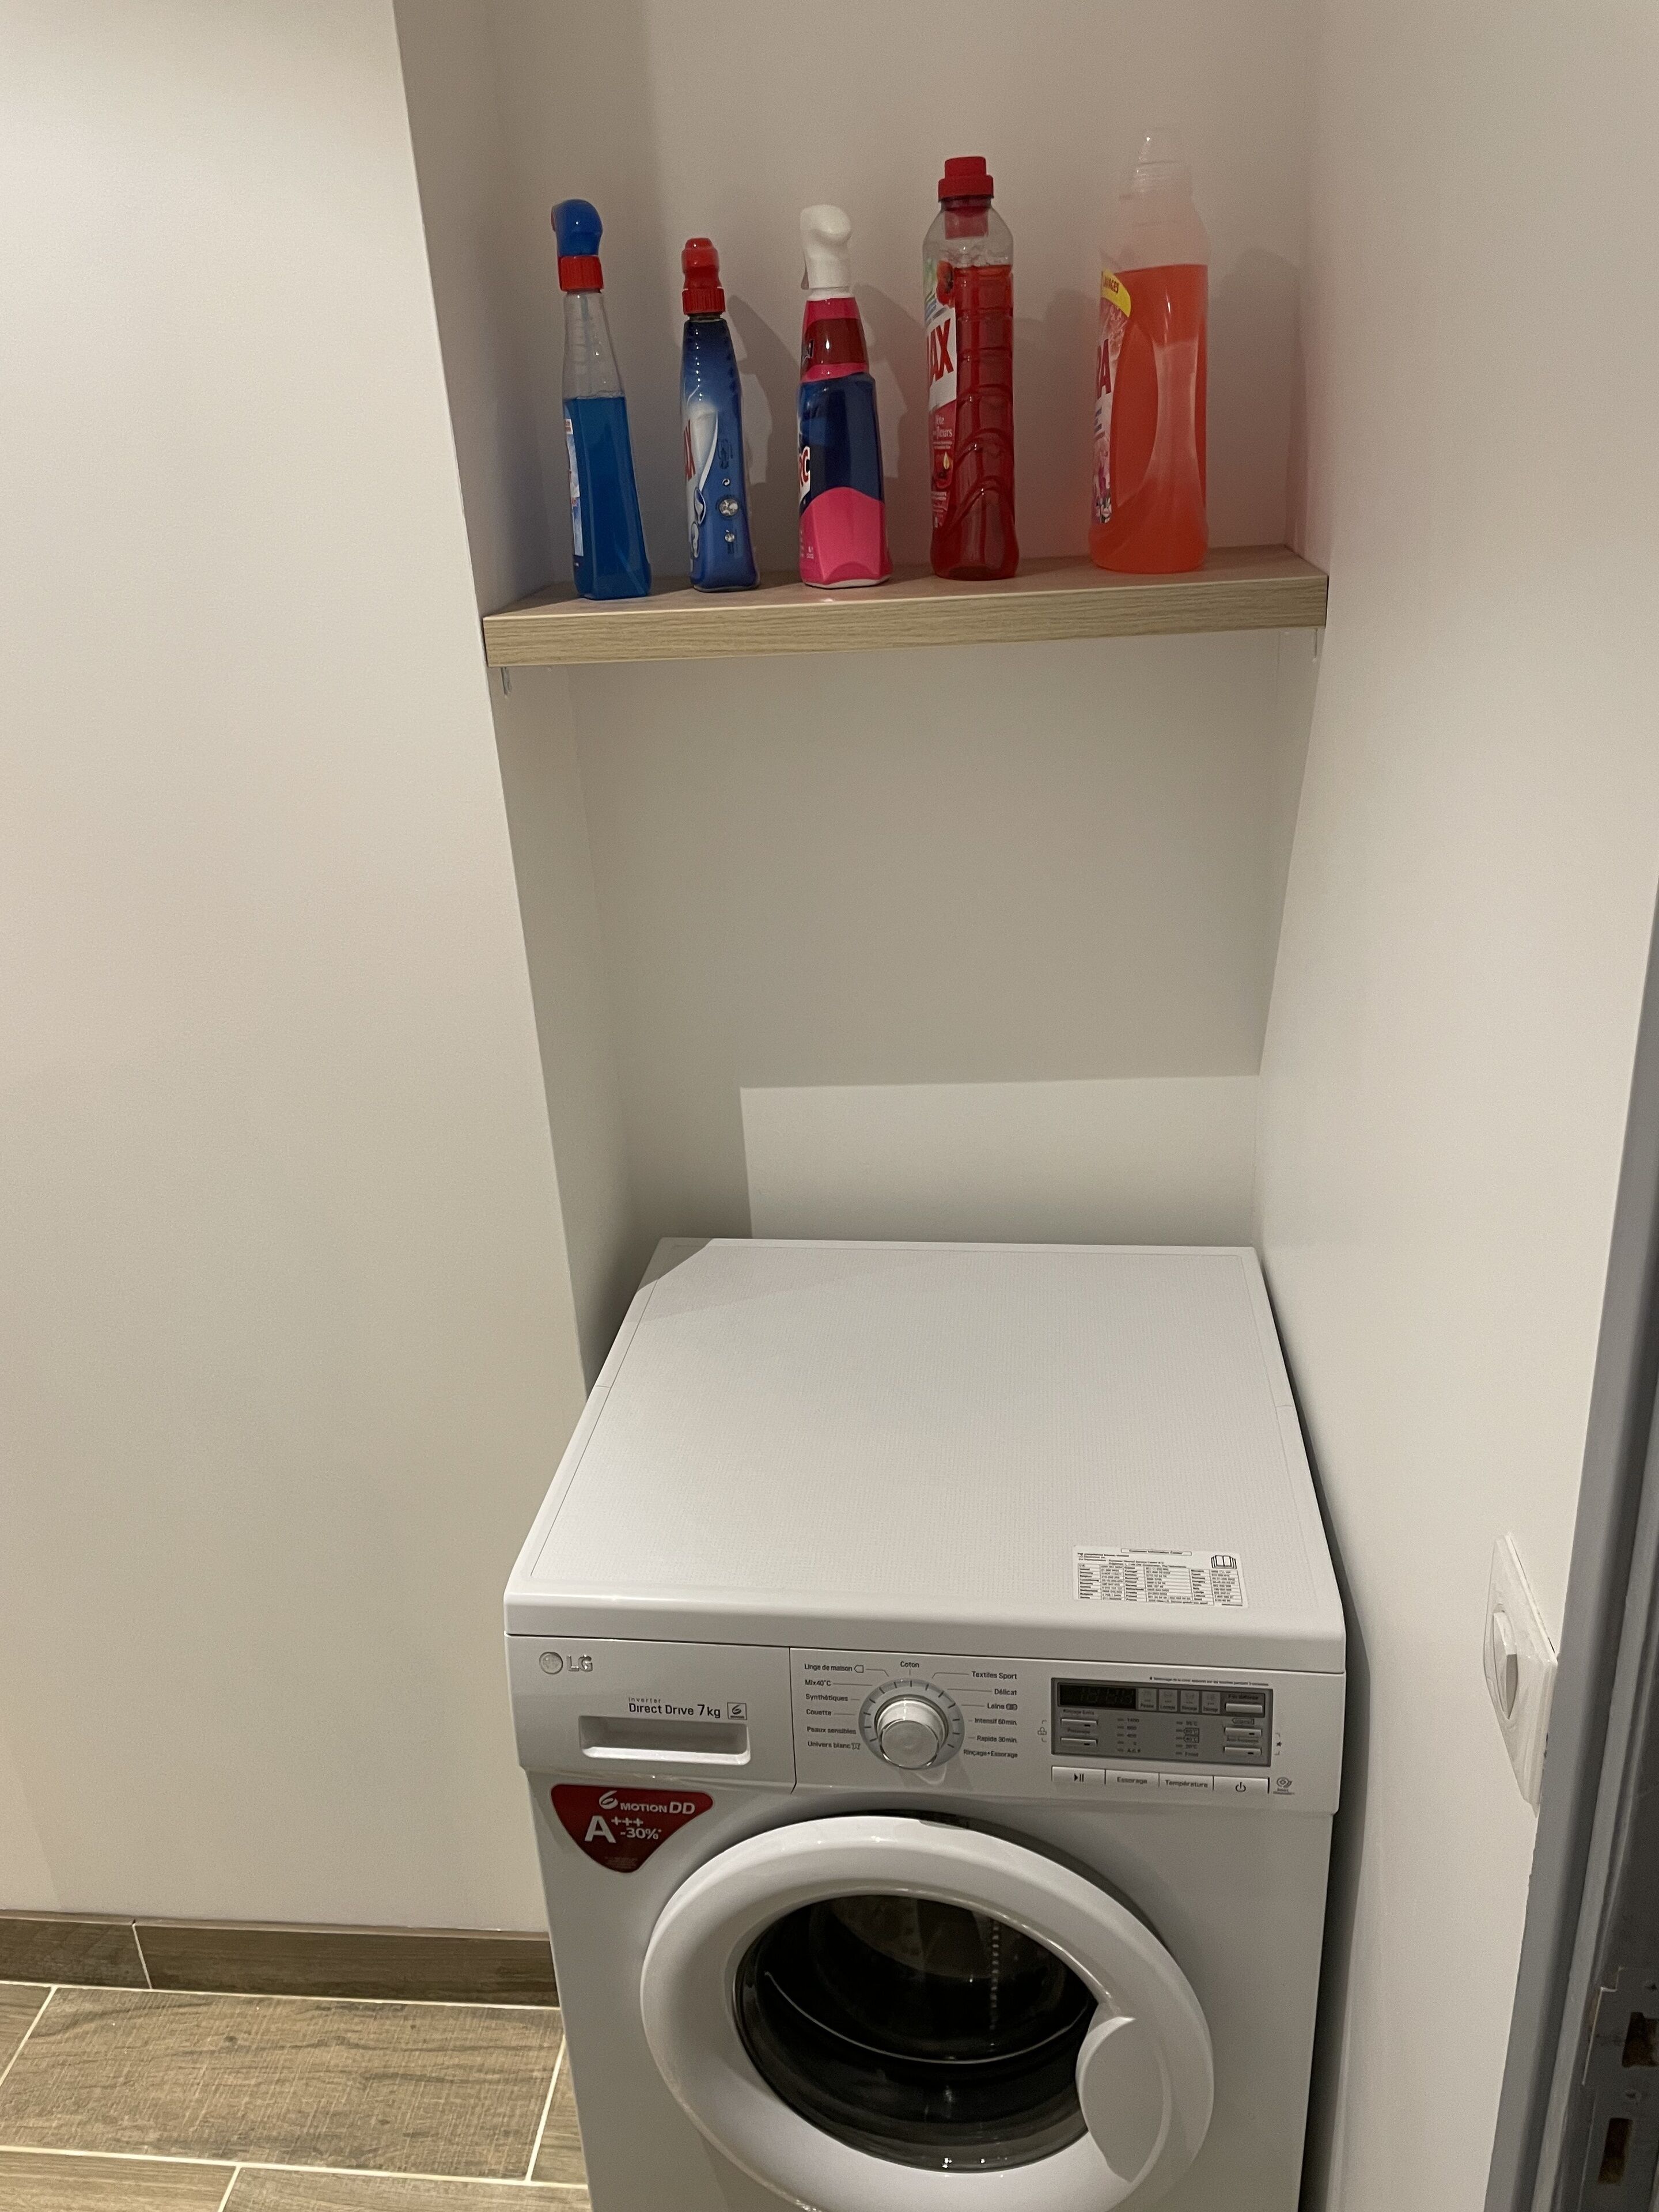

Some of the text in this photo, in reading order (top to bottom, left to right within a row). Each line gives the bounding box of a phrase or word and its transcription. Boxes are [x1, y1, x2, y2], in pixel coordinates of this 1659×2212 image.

[566, 1654, 593, 1672] LG
[629, 1703, 662, 1714] Direct
[665, 1705, 694, 1715] Drive
[620, 1802, 667, 1813] MOTION
[669, 1801, 696, 1815] DD
